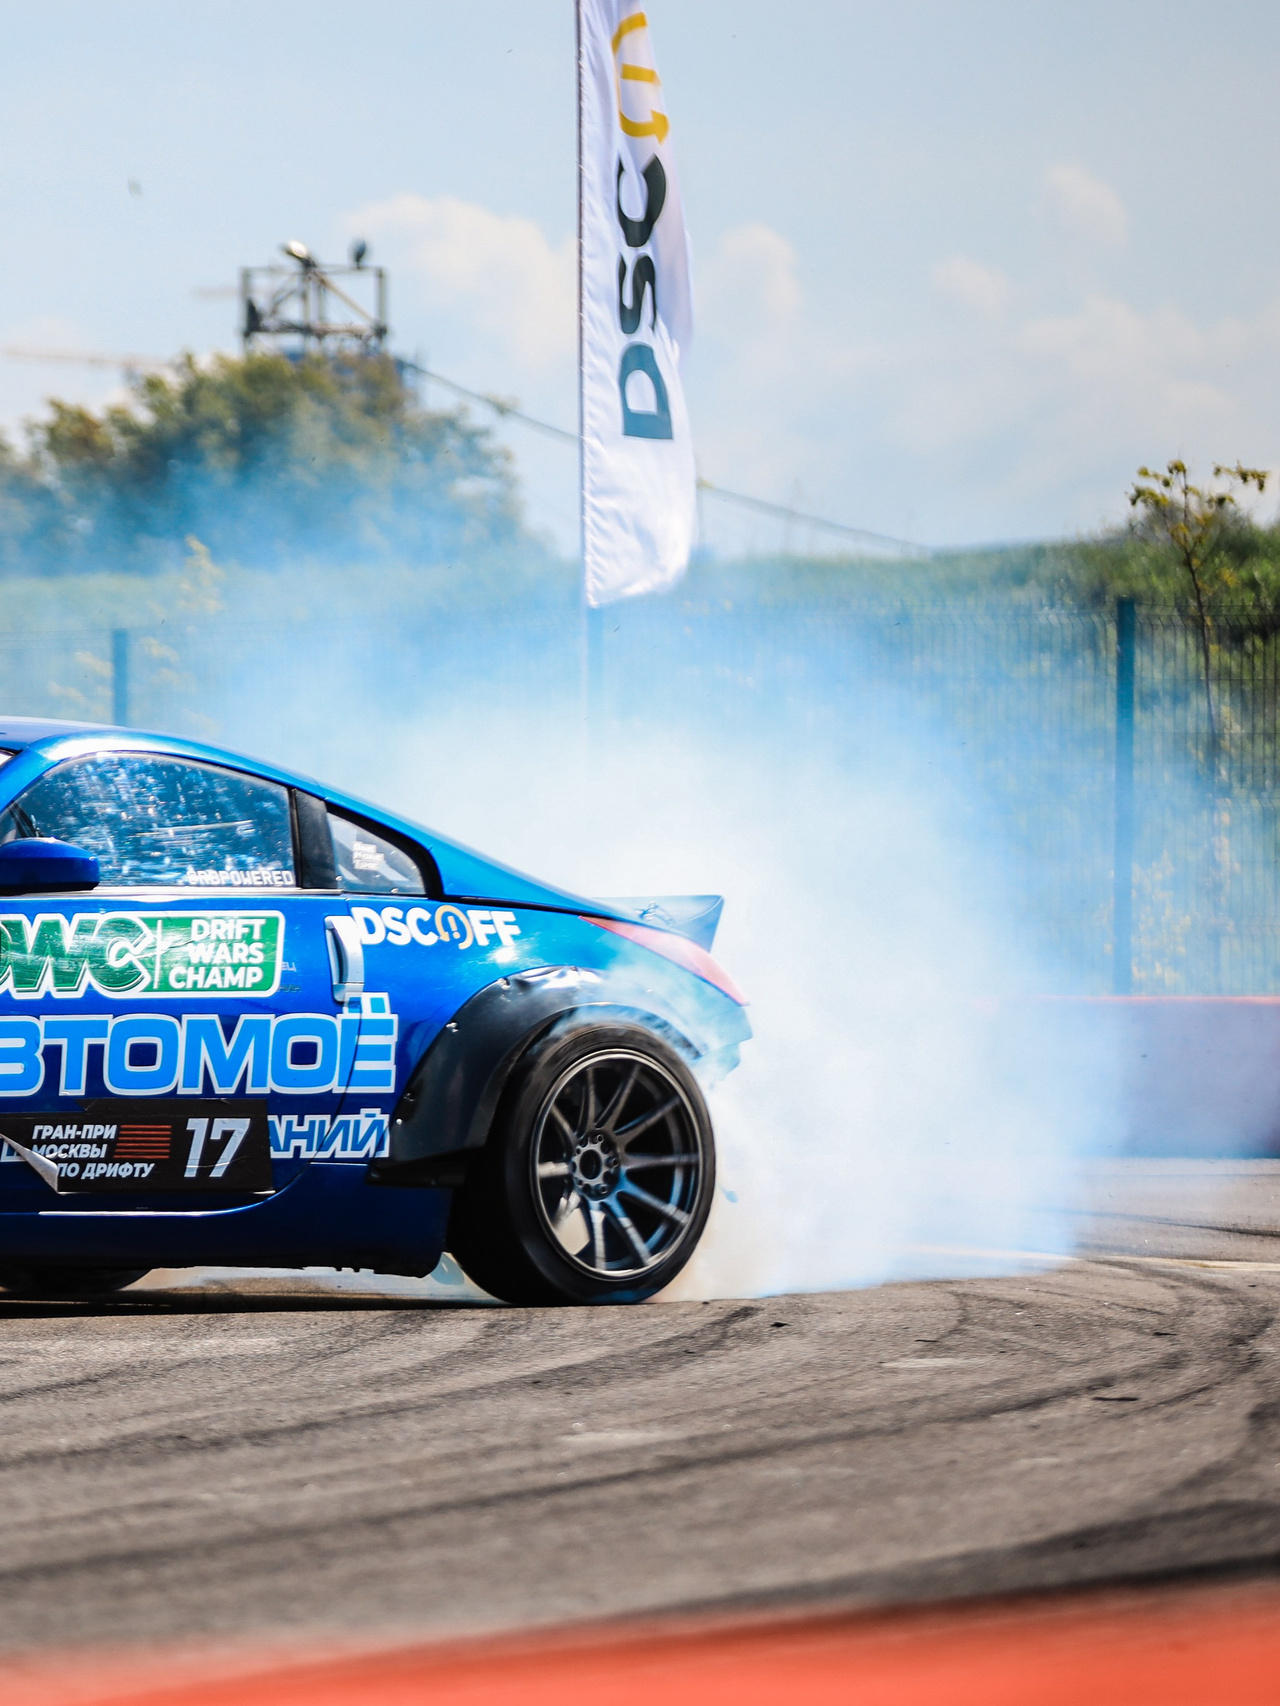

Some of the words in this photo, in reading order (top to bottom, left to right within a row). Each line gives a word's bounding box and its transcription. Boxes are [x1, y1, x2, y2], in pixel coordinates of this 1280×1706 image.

[192, 918, 266, 940] DRIFT
[188, 942, 265, 963] WARS
[169, 966, 263, 989] CHAMP
[32, 1124, 118, 1140] ГРАН-ПРИ
[31, 1143, 108, 1159] МОСКВЫ
[185, 1117, 252, 1179] 17
[56, 1162, 80, 1178] ПО
[81, 1162, 156, 1180] ДРИФТУ
